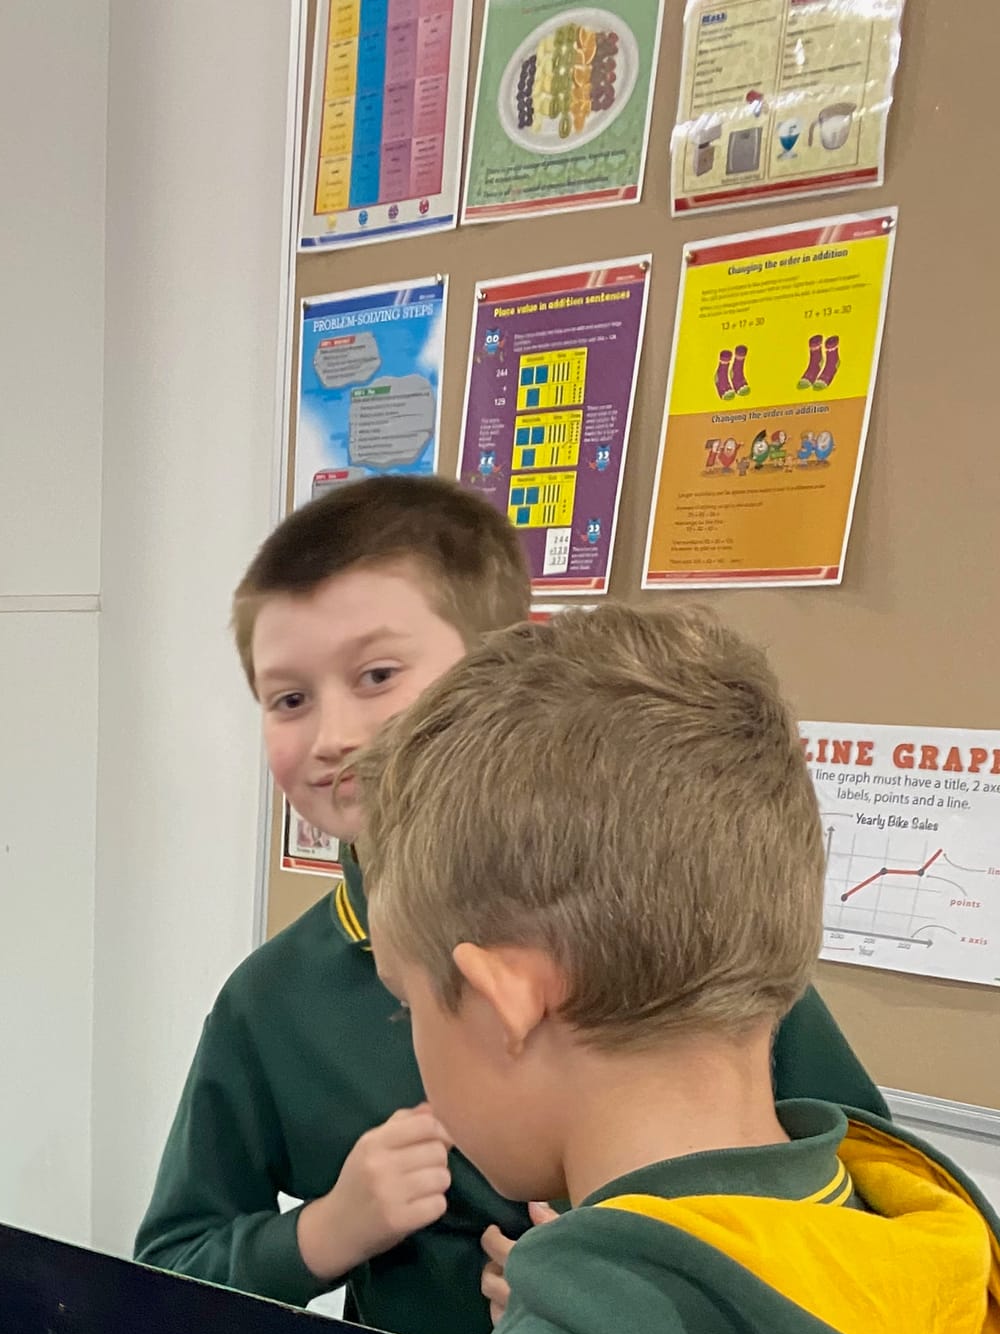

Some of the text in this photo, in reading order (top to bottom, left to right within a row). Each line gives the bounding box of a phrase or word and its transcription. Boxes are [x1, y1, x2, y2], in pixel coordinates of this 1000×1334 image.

[727, 249, 849, 276] Changing the order in addition
[494, 290, 631, 318] Place value in addition sentences
[803, 310, 813, 319] 17
[823, 307, 833, 317] 13
[312, 303, 434, 333] PROBLEM-SOLVING STEPS
[711, 404, 830, 424] Changing the order in addition
[815, 769, 836, 782] line
[837, 772, 870, 786] graph
[873, 775, 902, 787] must
[904, 775, 932, 789] have
[934, 779, 941, 789] a
[944, 778, 970, 793] title,
[972, 780, 980, 791] 2
[836, 787, 972, 810] labels, points and a line.
[856, 812, 939, 832] Yearly Bike Sales
[949, 898, 981, 908] points
[968, 937, 988, 945] axis
